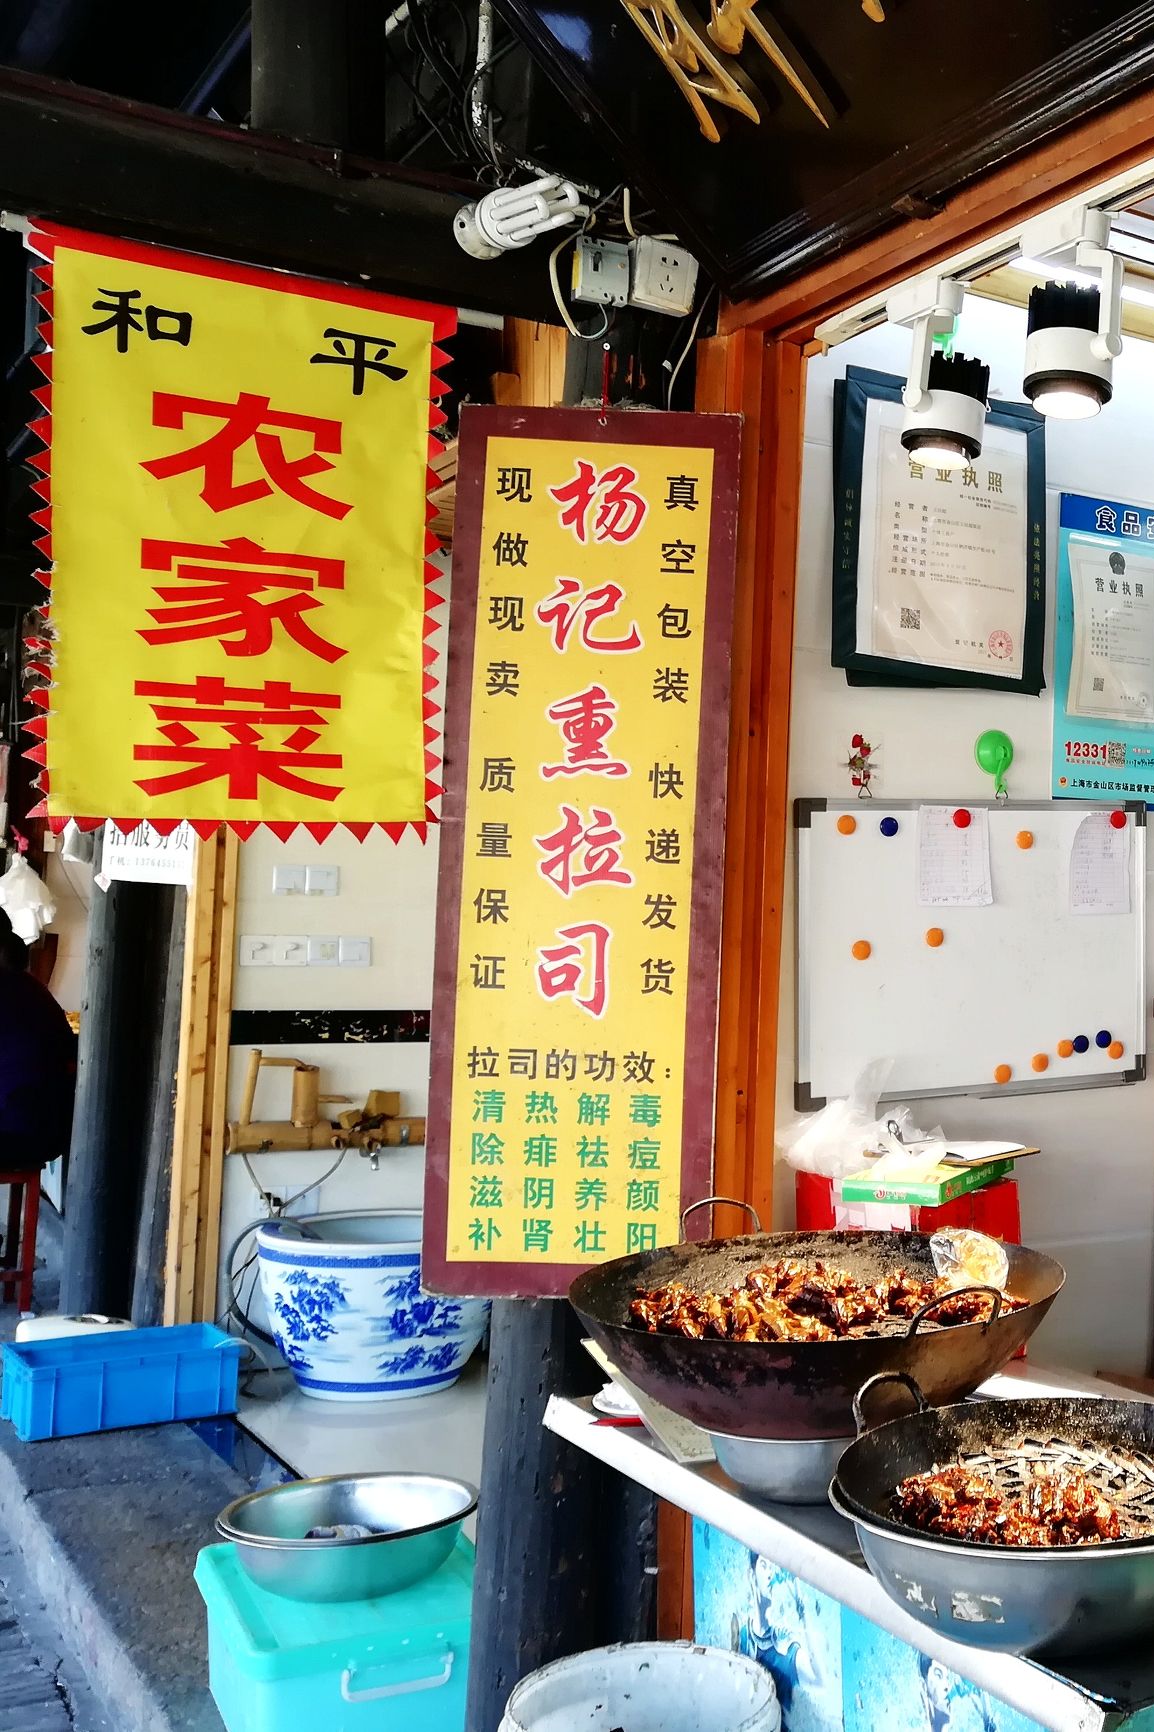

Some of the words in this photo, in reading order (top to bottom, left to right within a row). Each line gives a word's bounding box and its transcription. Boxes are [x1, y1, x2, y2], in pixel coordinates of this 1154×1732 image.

[81, 287, 409, 396] 和平
[909, 461, 1002, 493] 营业执照
[134, 391, 355, 802] 农家菜
[485, 467, 533, 698] 现做现卖
[652, 474, 700, 704] 真空包装
[1094, 577, 1145, 598] 营业执照
[1064, 741, 1107, 758] 12331
[470, 757, 516, 990] 质量保证
[640, 761, 685, 996] 快递发货
[471, 1089, 663, 1128] 清热解毒
[470, 1132, 661, 1171] 除痱祛痘
[469, 1175, 660, 1212] 滋阴养颜
[468, 1217, 658, 1254] 补肾壮阳
